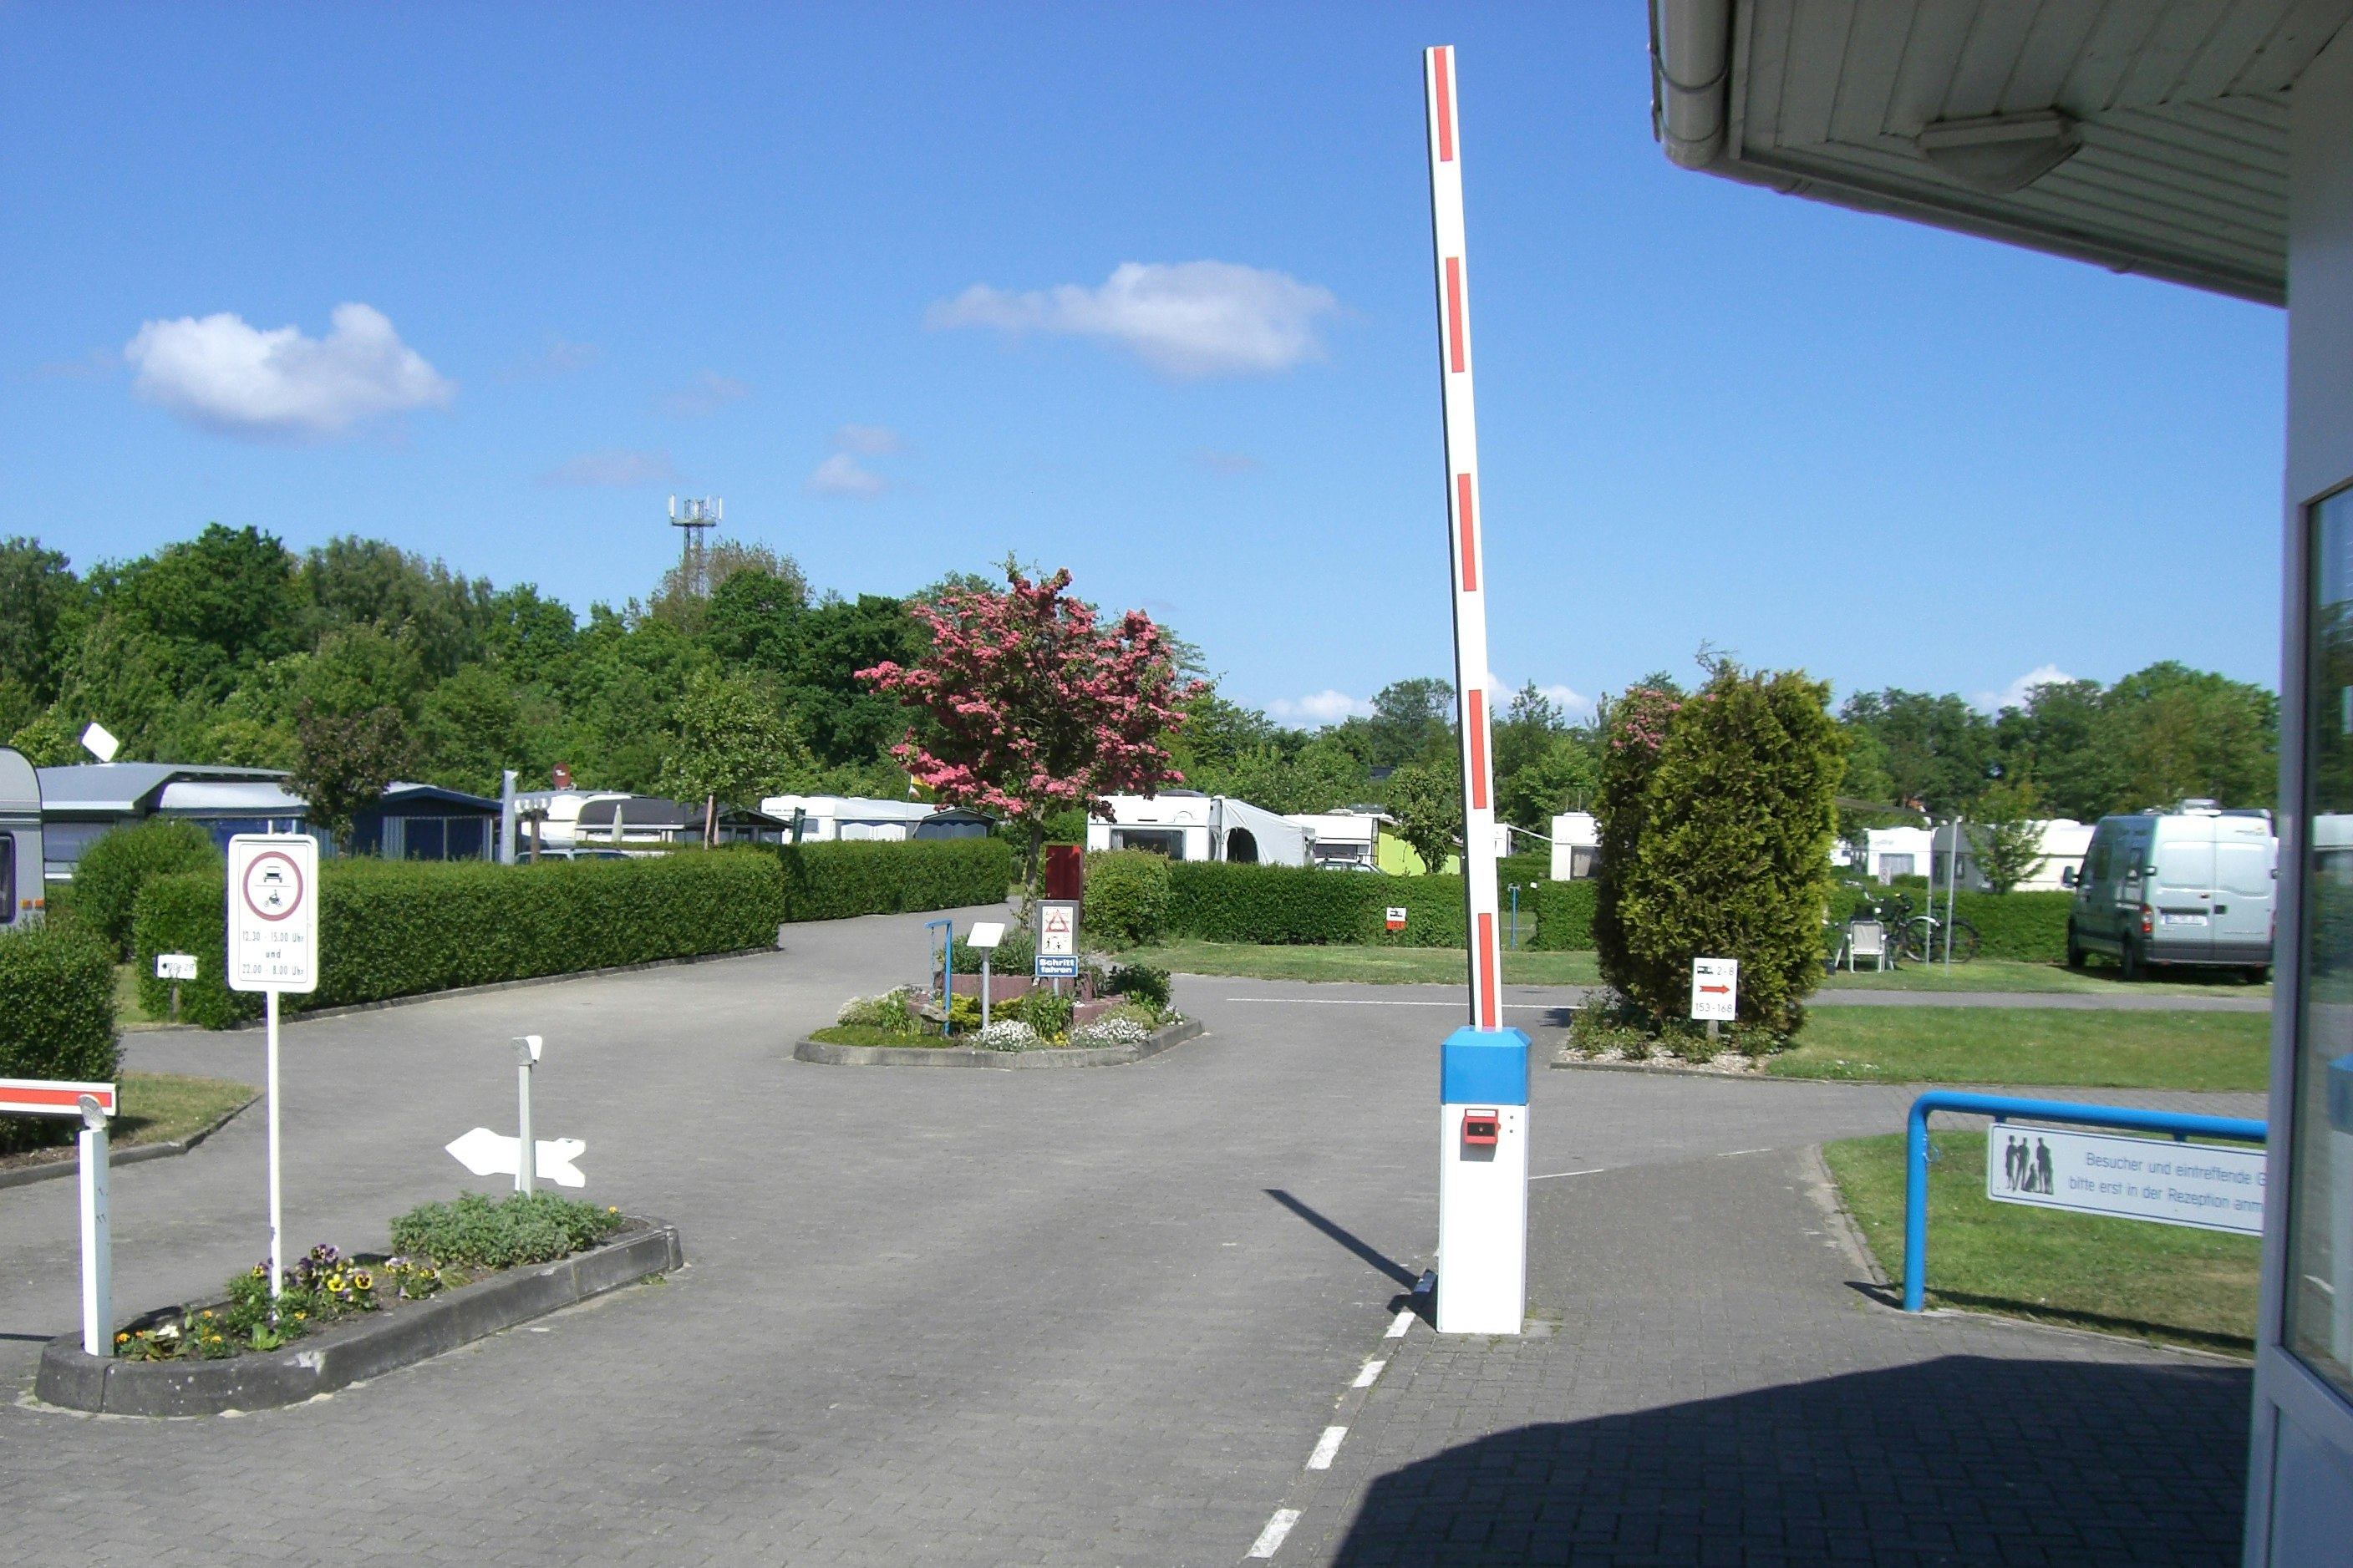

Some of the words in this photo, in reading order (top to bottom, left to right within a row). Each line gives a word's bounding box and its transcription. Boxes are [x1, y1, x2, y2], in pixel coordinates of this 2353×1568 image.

[292, 932, 304, 943] Uhr
[265, 948, 282, 959] und
[292, 966, 304, 977] Uhr
[2086, 1152, 2142, 1170] Besucher
[2148, 1161, 2172, 1175] und
[2176, 1162, 2252, 1185] eintreffende
[2068, 1175, 2095, 1192] bitte
[2100, 1181, 2122, 1195] erst
[2127, 1183, 2137, 1197] in
[2142, 1185, 2163, 1200] der
[2168, 1187, 2229, 1209] Rezeption
